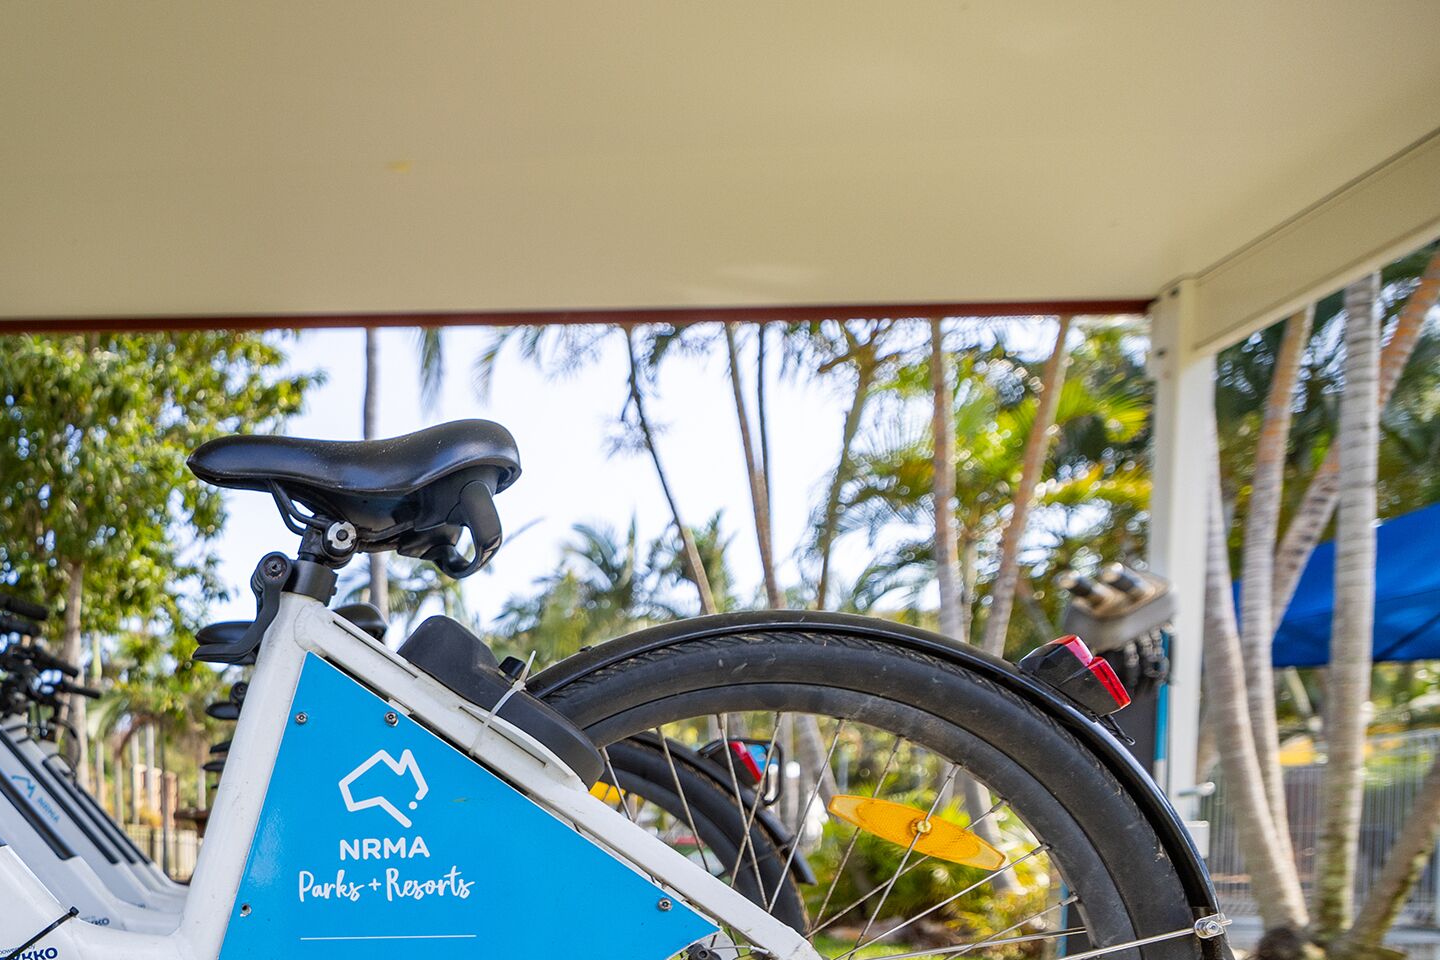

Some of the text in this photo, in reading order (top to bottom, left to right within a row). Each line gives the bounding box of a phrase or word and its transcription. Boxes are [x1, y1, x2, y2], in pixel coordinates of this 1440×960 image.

[339, 835, 431, 861] NRMA
[298, 865, 475, 902] Parks + Resorts
